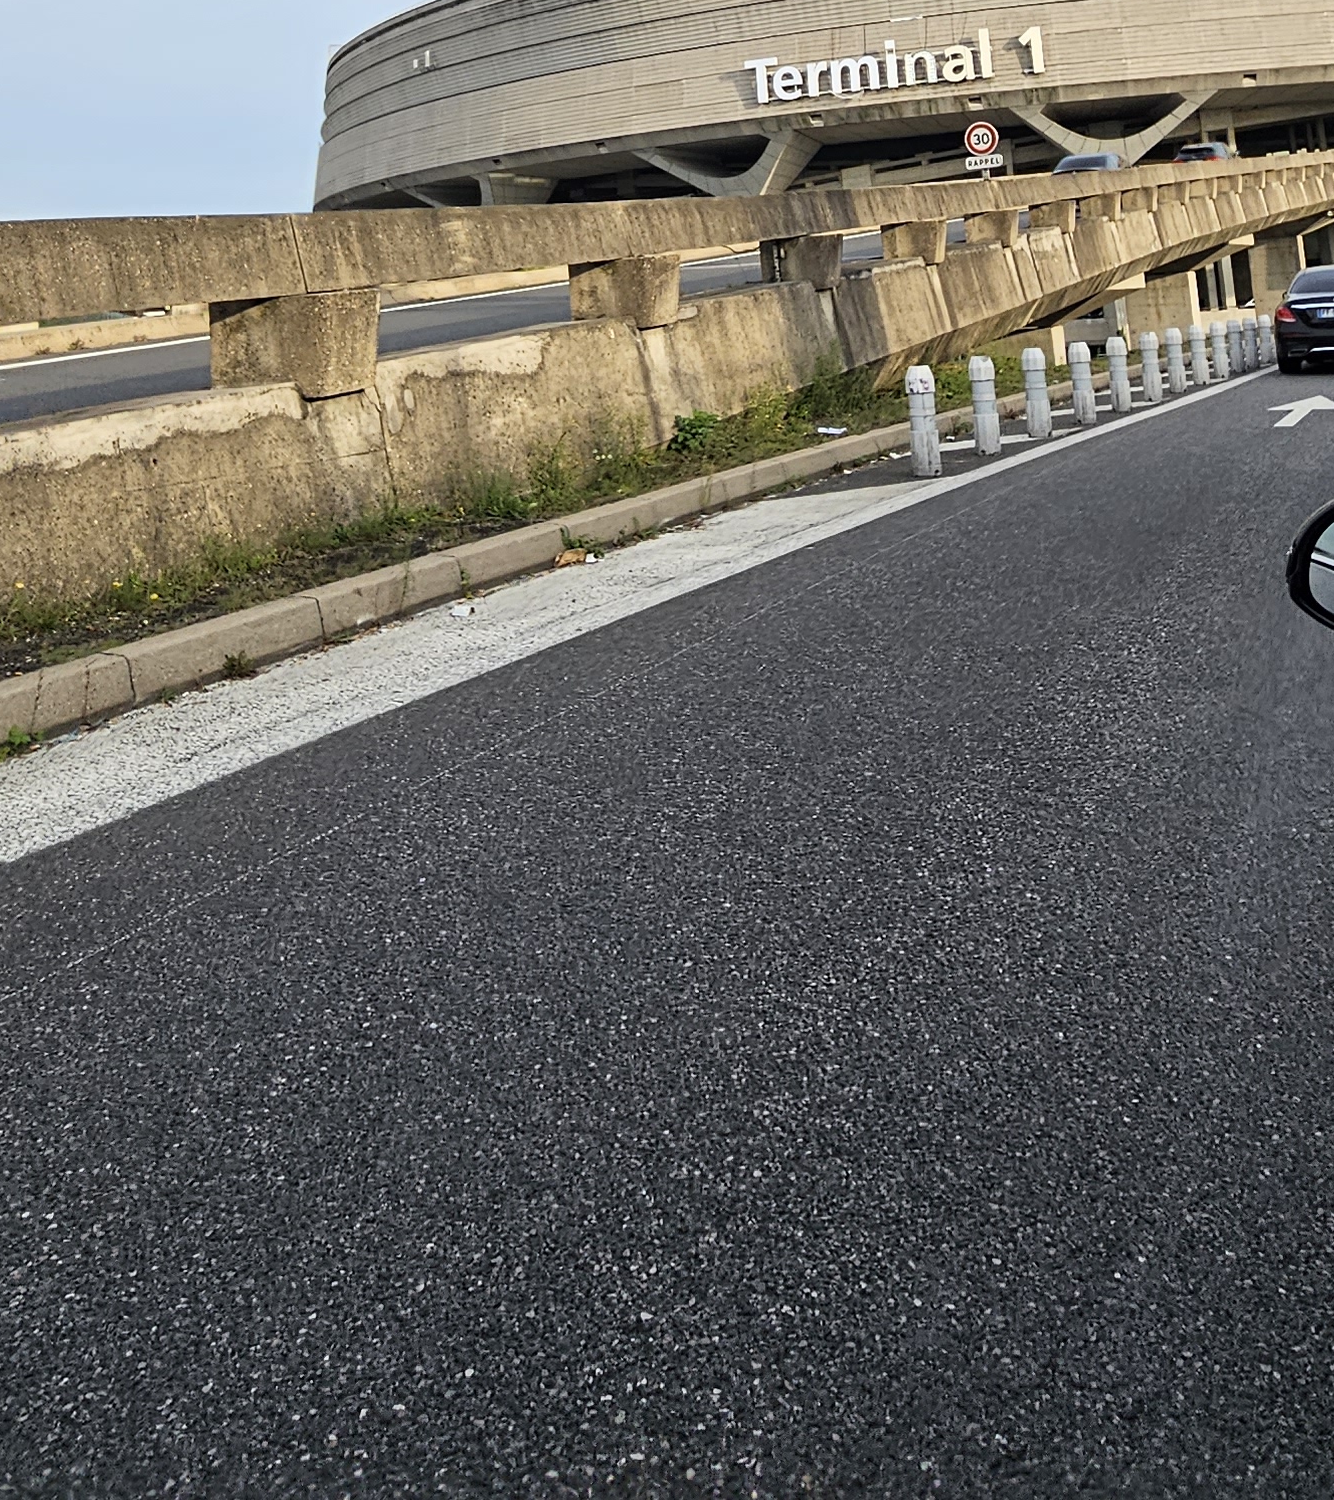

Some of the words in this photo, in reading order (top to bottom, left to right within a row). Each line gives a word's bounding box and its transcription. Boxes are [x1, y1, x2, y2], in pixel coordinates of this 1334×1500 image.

[744, 28, 995, 104] Terminal
[1018, 26, 1046, 75] 1
[973, 133, 990, 146] 30
[968, 157, 999, 167] RAPPEL
